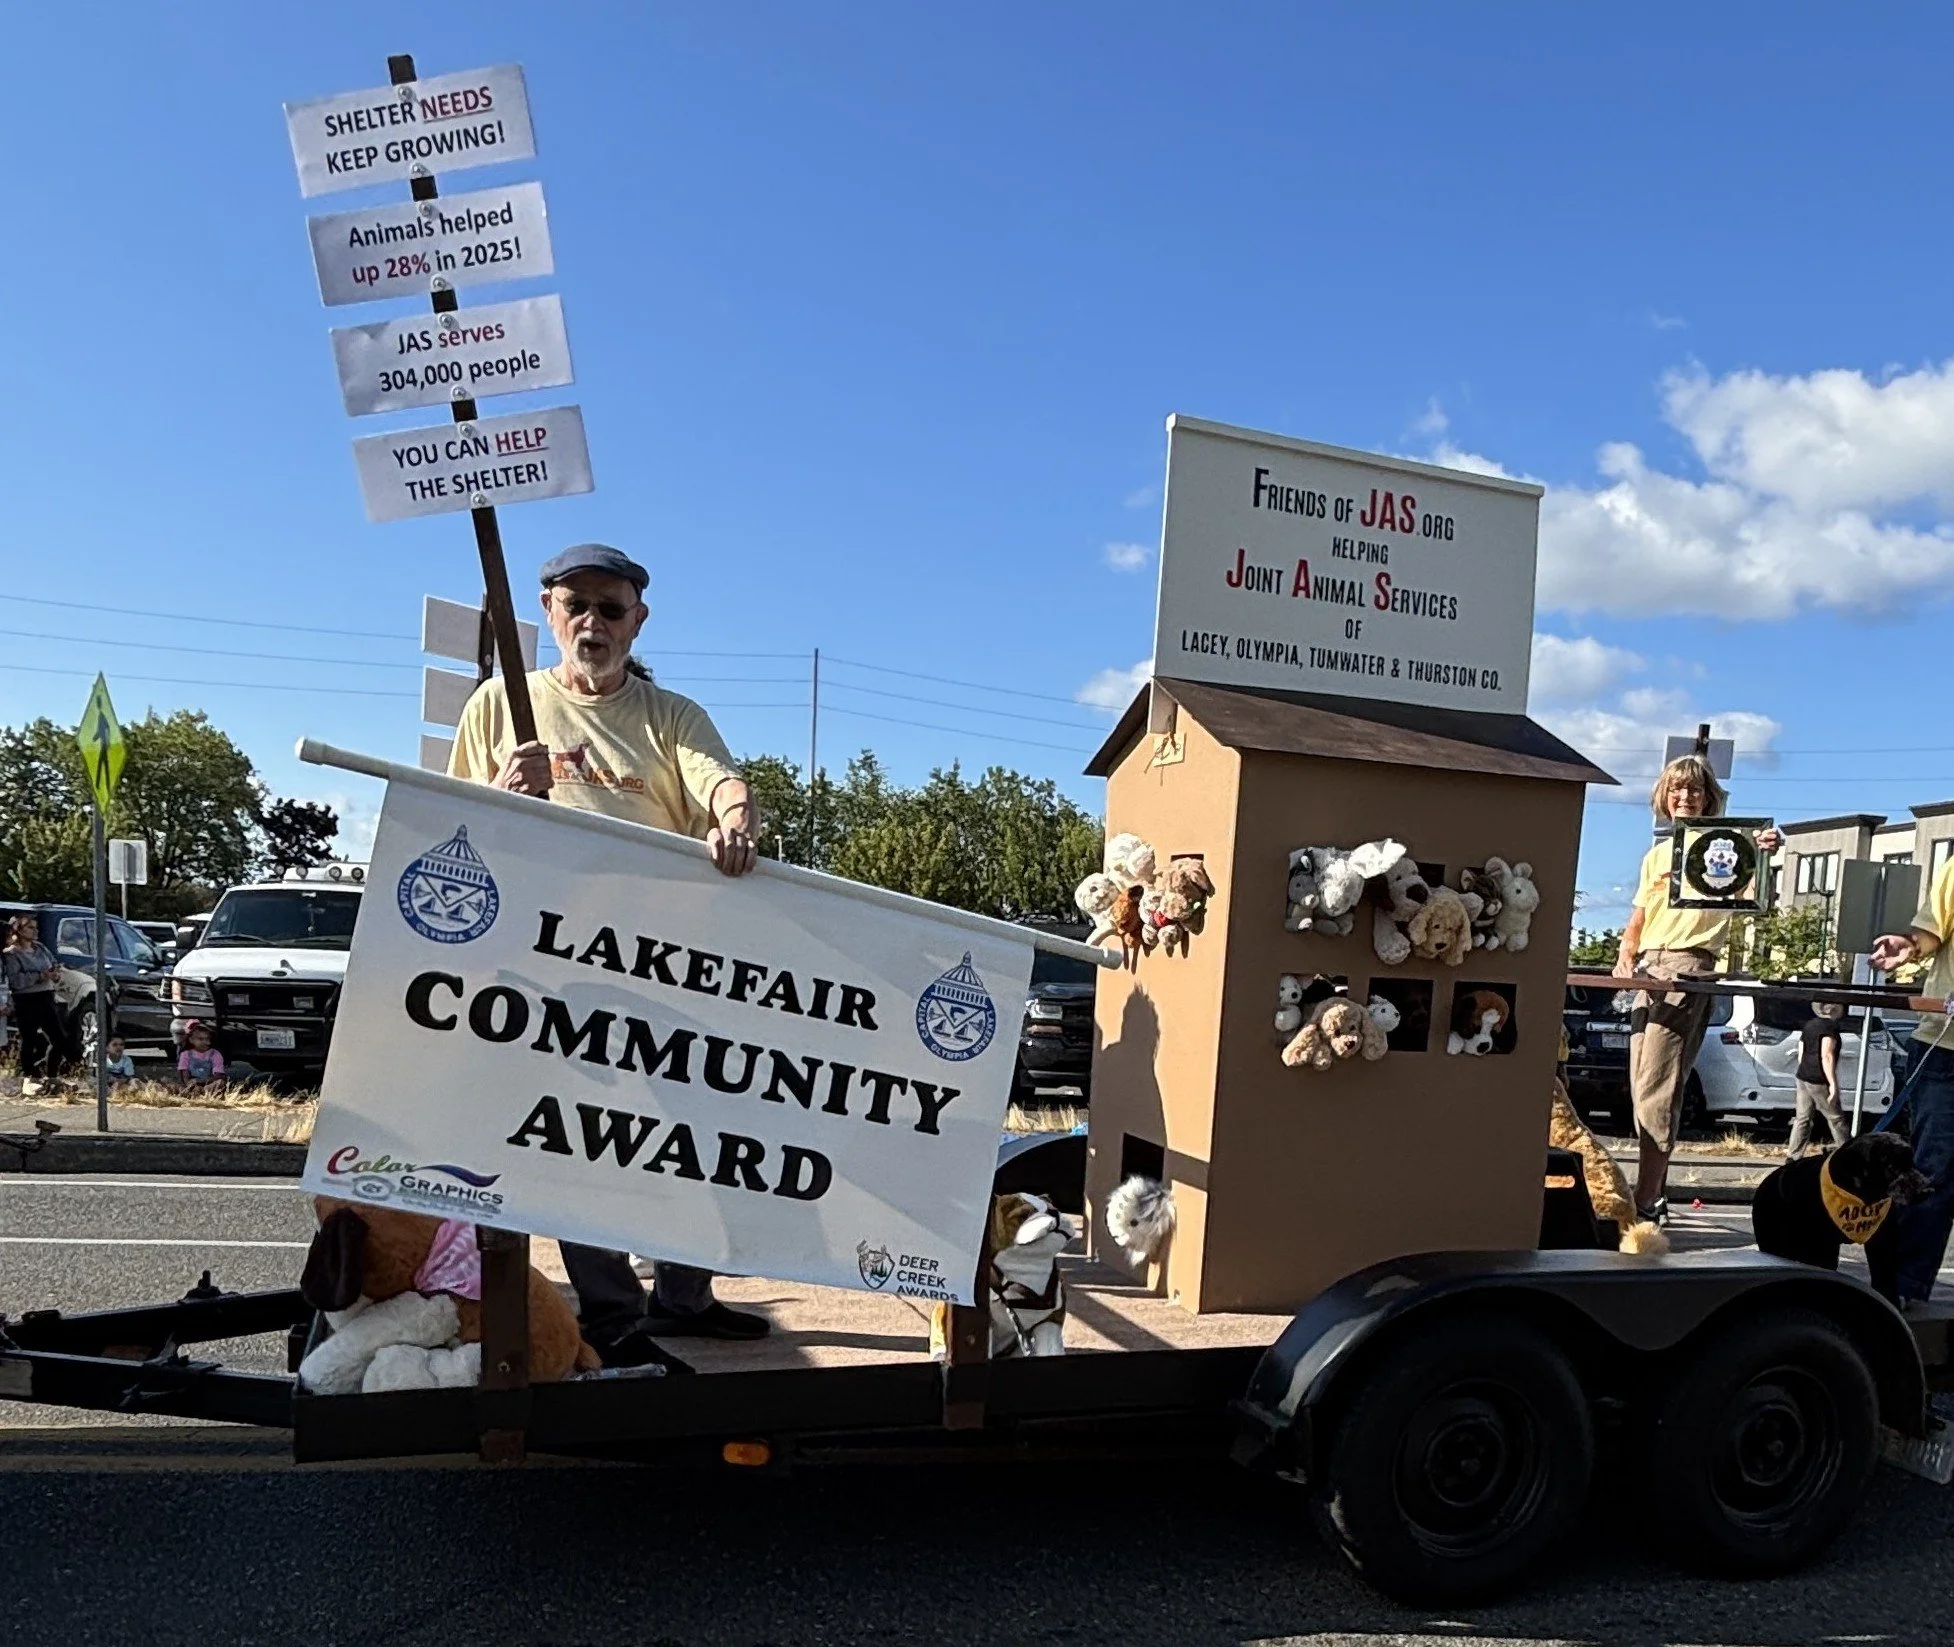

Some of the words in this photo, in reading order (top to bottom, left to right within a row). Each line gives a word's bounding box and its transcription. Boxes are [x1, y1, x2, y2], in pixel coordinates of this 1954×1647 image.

[325, 100, 416, 137] SHELTER
[421, 86, 493, 122] NEEDS
[326, 145, 378, 174] KEEP
[385, 121, 505, 164] GROWING!
[349, 215, 434, 248] Animals
[439, 202, 513, 237] helped
[352, 260, 380, 286] up
[386, 251, 431, 278] 28%
[436, 250, 456, 272] in
[461, 237, 522, 267] 2025!
[398, 330, 432, 355] JAS
[438, 323, 505, 348] serves
[378, 361, 464, 393] 304,000
[469, 350, 541, 384] people
[393, 442, 438, 469] YOU
[445, 435, 489, 461] CAN
[496, 426, 549, 455] HELP
[405, 477, 448, 502] THE
[453, 461, 548, 495] SHELTER!
[1253, 468, 1326, 519] FRIENDS
[1334, 497, 1355, 523] OF
[1332, 537, 1389, 564] HELPING
[1226, 549, 1284, 595] JOINT
[1292, 560, 1366, 608] ANIMAL
[1374, 572, 1458, 620] SERVICES
[1344, 619, 1362, 639] OF
[1182, 630, 1230, 659] LACEY,
[1236, 638, 1303, 669] OLYMPIA,
[1309, 647, 1385, 677] TUMWATER
[1391, 658, 1400, 676] &
[1408, 660, 1477, 687] THURSTON
[1482, 670, 1502, 691] CO.
[533, 911, 879, 1031] LAKEFAIR
[404, 971, 961, 1136] COMMUNITY
[327, 1146, 418, 1175] Color
[506, 1095, 834, 1202] AWARD
[400, 1175, 504, 1205] GRAPHICS
[897, 1270, 946, 1289] CREEK
[899, 1255, 939, 1272] DEER
[897, 1285, 959, 1302] AWARDS
